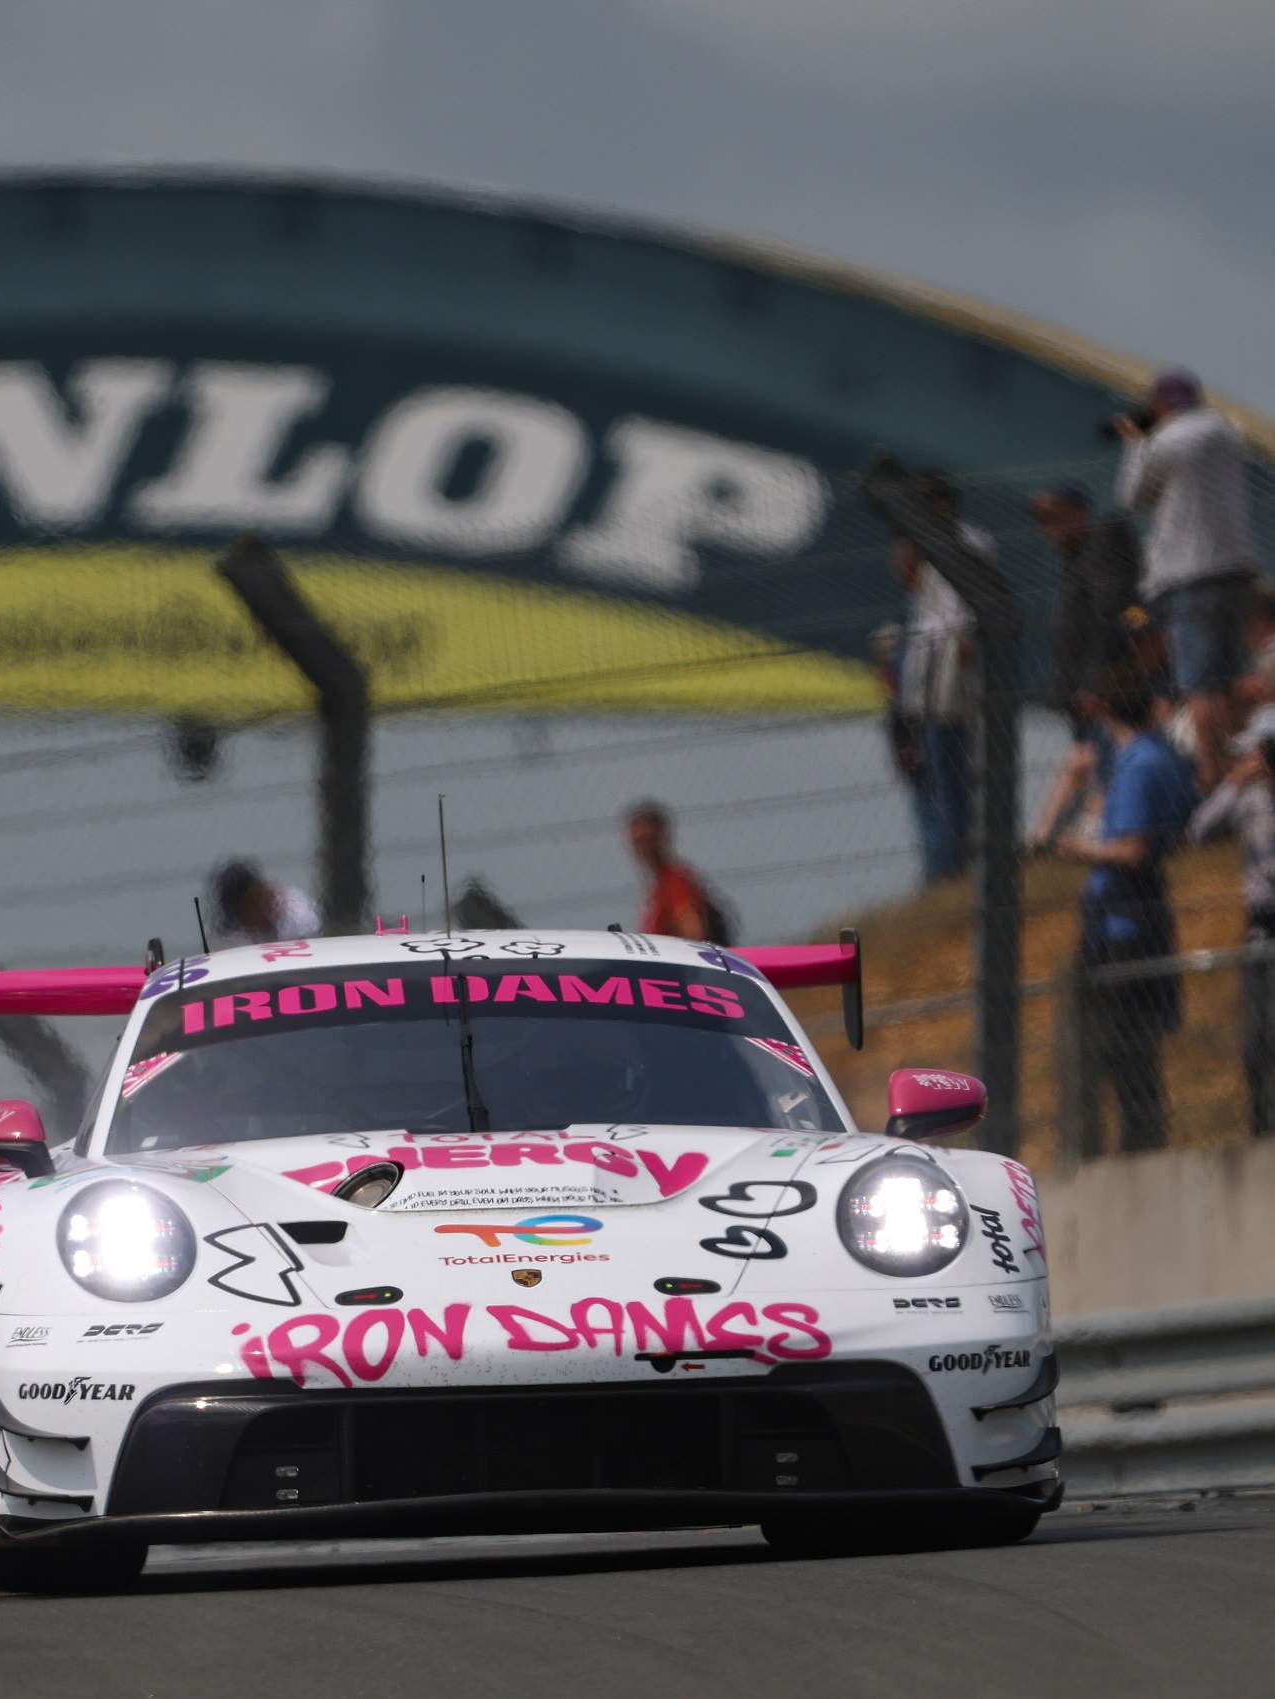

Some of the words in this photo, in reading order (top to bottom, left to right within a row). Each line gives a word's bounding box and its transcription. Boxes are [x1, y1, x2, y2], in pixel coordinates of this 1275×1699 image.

[181, 977, 406, 1035] IRON
[431, 975, 746, 1019] DAMES
[389, 1131, 596, 1143] TOTAL
[449, 1189, 473, 1197] YOUR
[498, 1187, 522, 1195] WHEN
[970, 1204, 1020, 1274] total
[438, 1252, 610, 1266] TotalEnergies
[486, 1295, 832, 1364] DAMES
